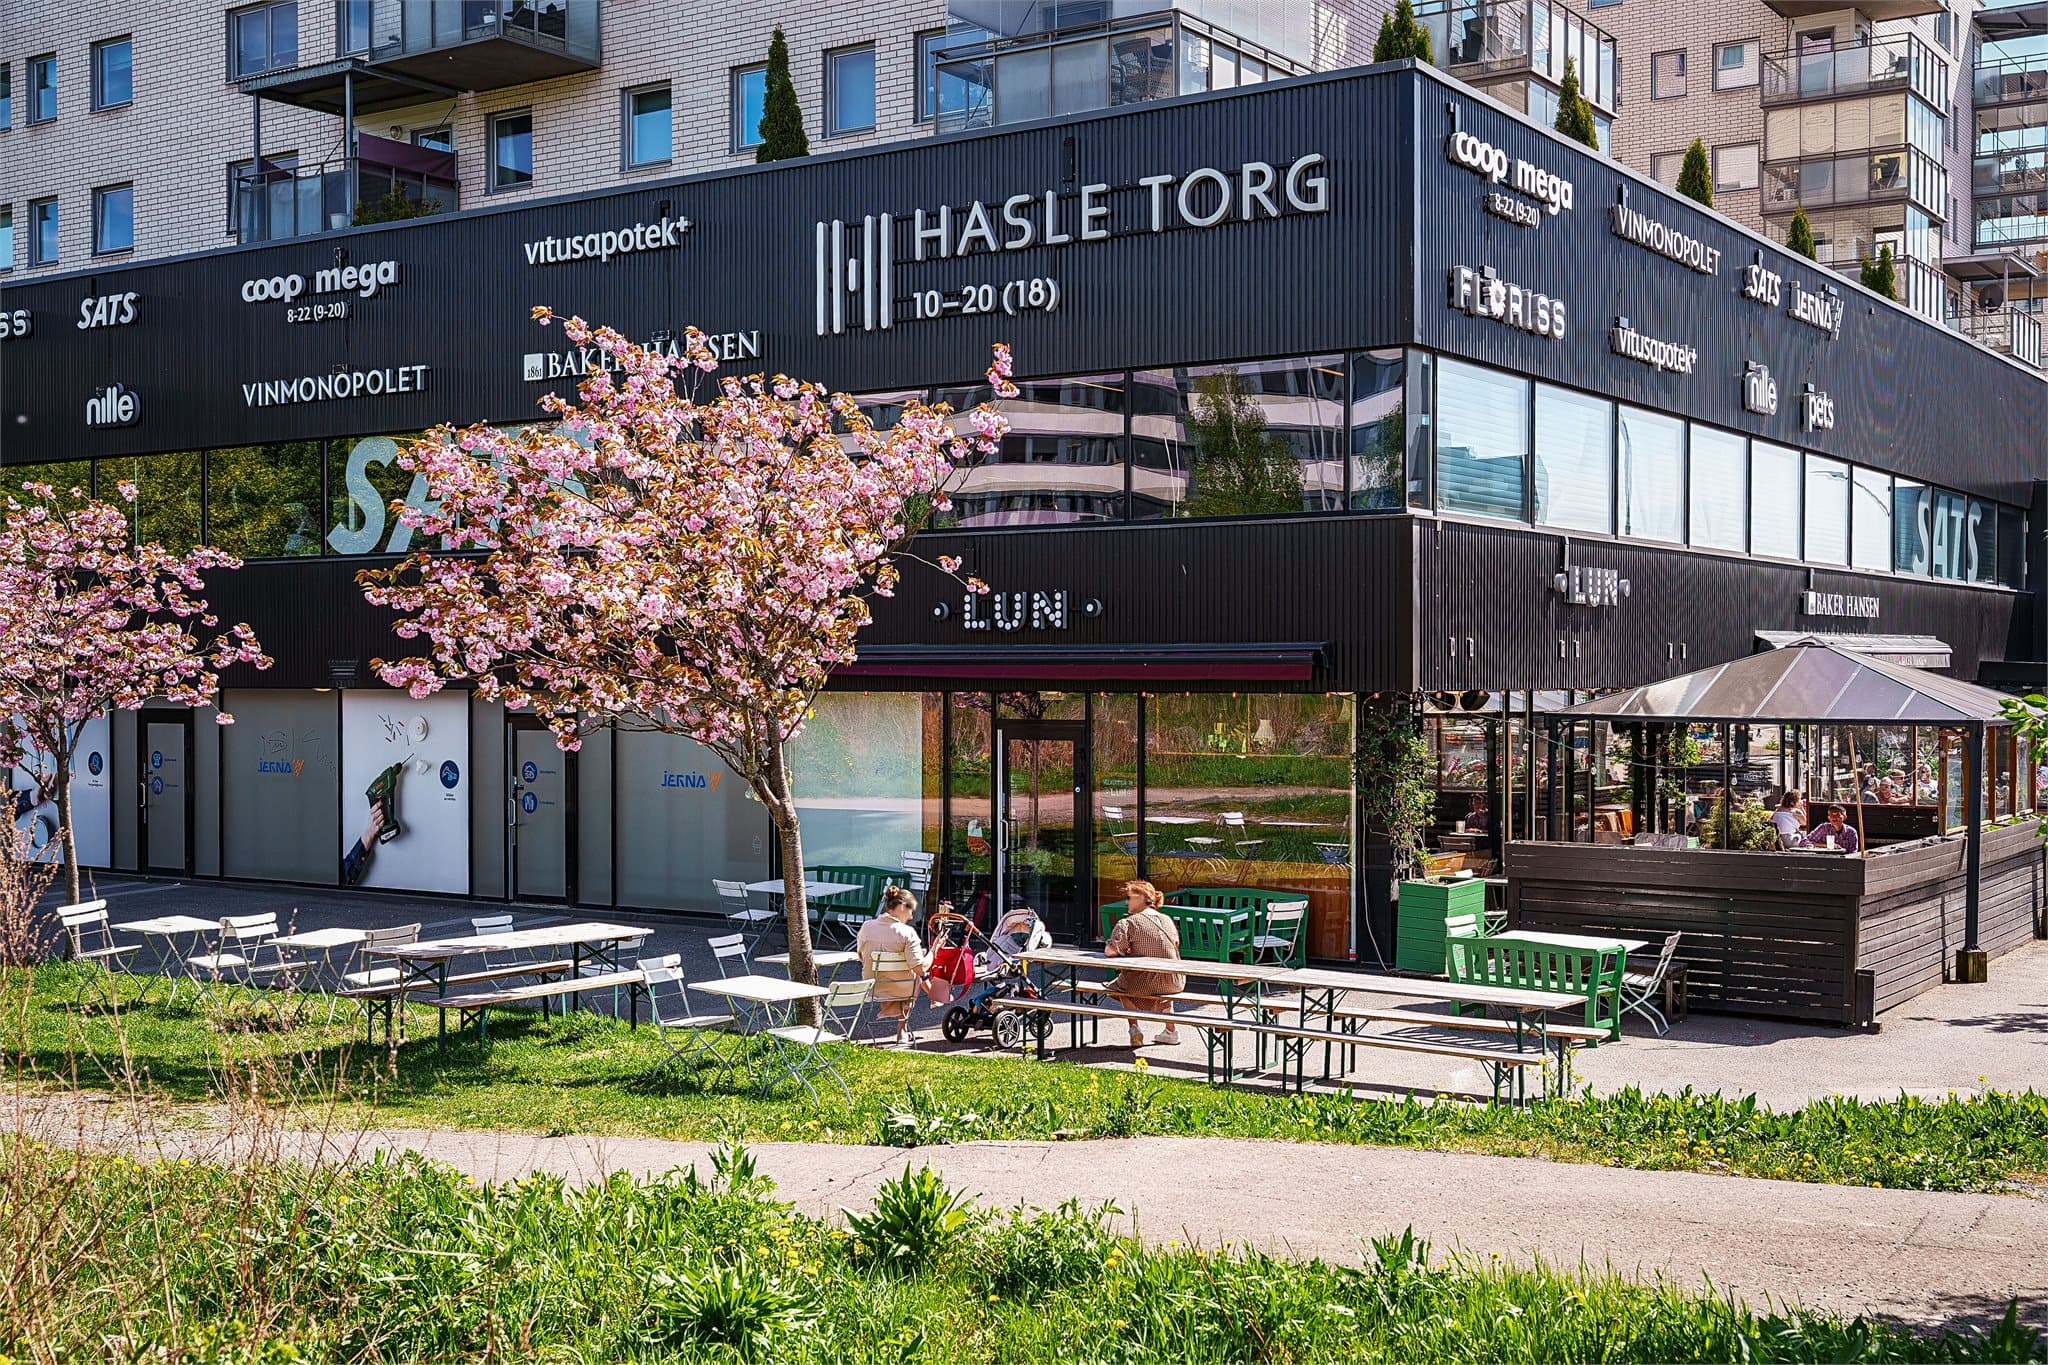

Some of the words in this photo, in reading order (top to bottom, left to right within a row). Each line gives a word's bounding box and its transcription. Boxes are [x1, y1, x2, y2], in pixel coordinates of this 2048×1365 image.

[1455, 131, 1508, 184] coop
[1517, 158, 1573, 216] mega
[914, 182, 1111, 261] HASLE
[1138, 152, 1330, 233] TORG
[1495, 193, 1515, 217] 8-22
[1515, 200, 1540, 230] (9-20)
[1618, 203, 1721, 277] VINMONOPOLET
[241, 273, 304, 304] coop
[315, 260, 398, 298] mega
[1002, 276, 1060, 317] (18)
[1750, 264, 1782, 307] SATS
[76, 291, 138, 330] SATS
[287, 306, 311, 324] 8-22
[313, 301, 346, 322] (9-20)
[86, 385, 137, 426] nille
[242, 364, 428, 408] VINMONOPOLET
[1750, 368, 1778, 412] nille
[1808, 391, 1835, 433] pets
[1912, 488, 1983, 584] SATS
[1571, 566, 1618, 608] LUN
[1816, 592, 1845, 617] BAKER
[1846, 595, 1880, 618] HANSEN
[963, 590, 1070, 631] LUN
